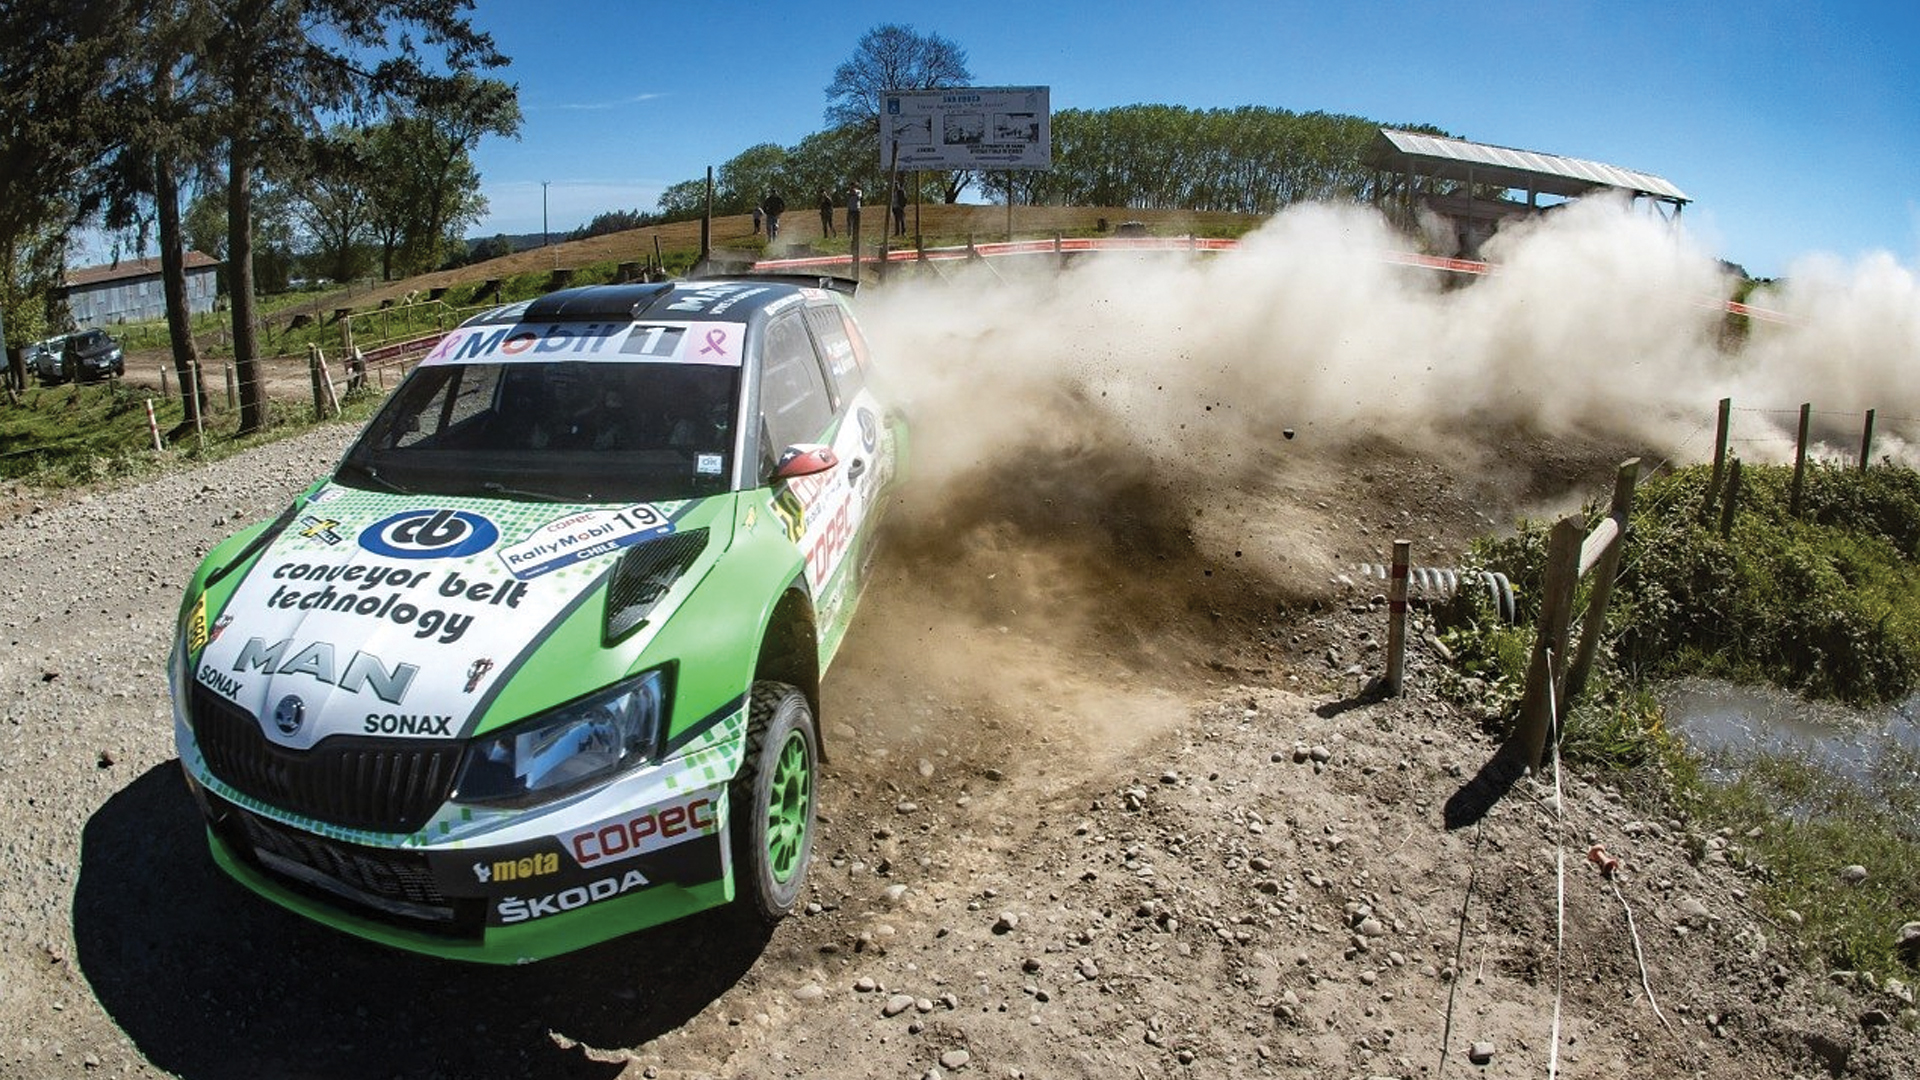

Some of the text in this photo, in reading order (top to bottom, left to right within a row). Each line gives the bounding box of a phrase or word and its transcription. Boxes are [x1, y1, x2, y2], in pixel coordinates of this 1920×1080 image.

[454, 323, 617, 361] Mobil
[613, 506, 658, 530] 19
[577, 541, 621, 560] CHILE
[806, 493, 853, 587] OPEC
[272, 562, 529, 609] conveyor belt
[266, 585, 475, 645] technology
[199, 665, 243, 700] SONAX
[232, 637, 421, 706] MAN
[363, 713, 453, 736] SONAX
[571, 798, 716, 864] COPEC
[492, 852, 559, 882] mota
[497, 868, 650, 924] ŠKODA
